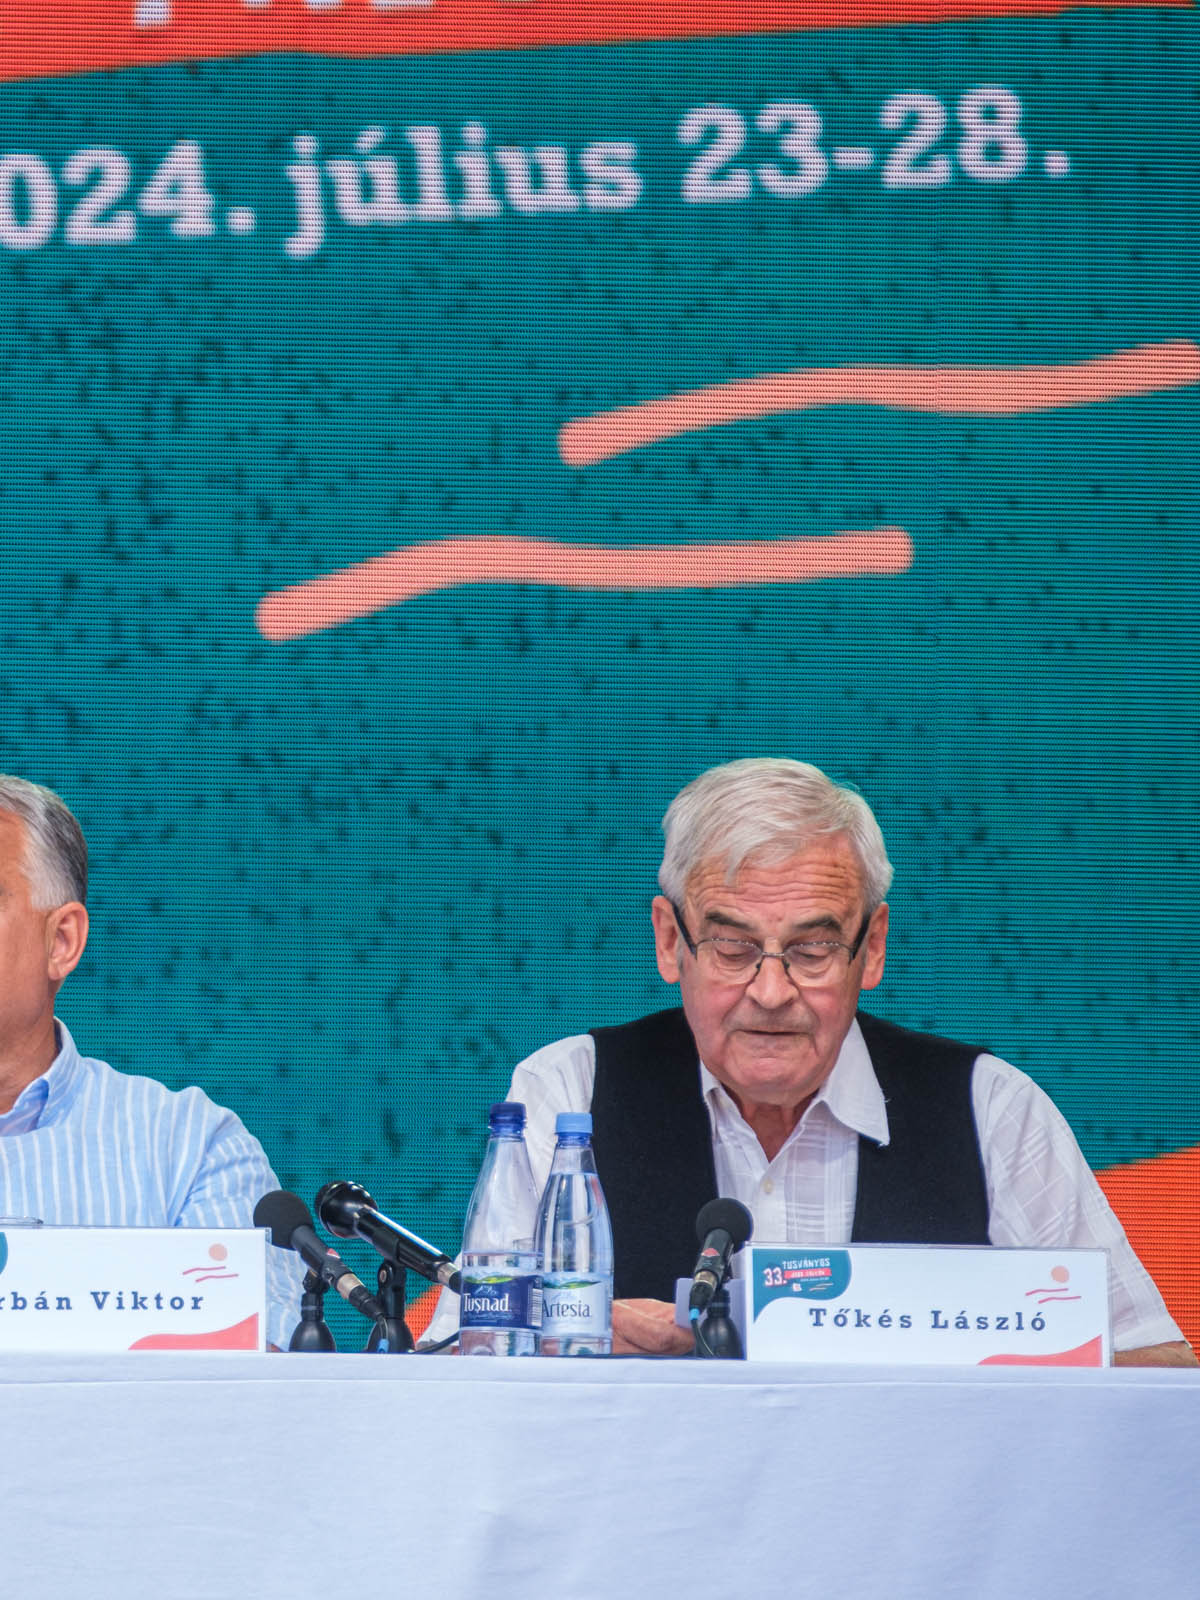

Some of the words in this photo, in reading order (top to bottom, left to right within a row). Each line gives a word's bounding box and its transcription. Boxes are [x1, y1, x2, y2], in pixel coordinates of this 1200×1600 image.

[284, 121, 644, 259] július
[677, 83, 1072, 203] 23-28.
[90, 1291, 204, 1311] Viktor
[808, 1307, 913, 1329] Tőkés
[930, 1310, 1047, 1332] László
